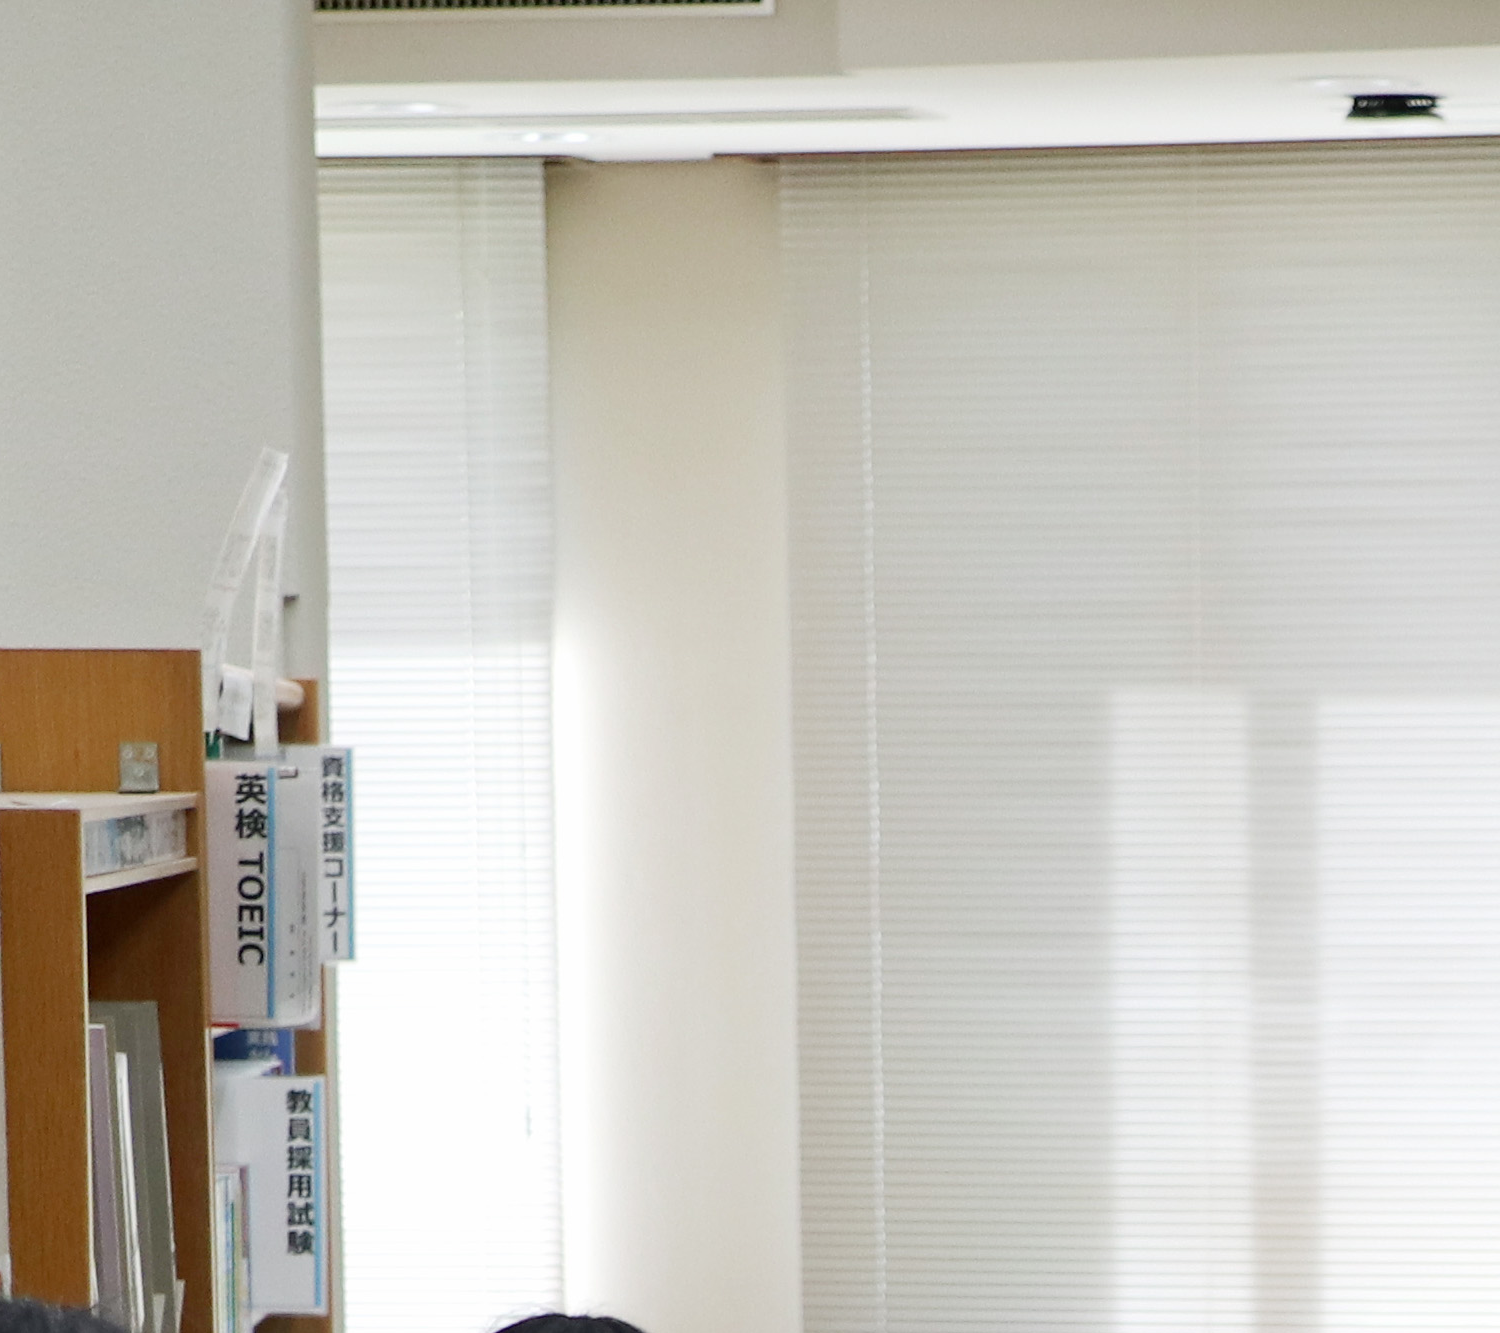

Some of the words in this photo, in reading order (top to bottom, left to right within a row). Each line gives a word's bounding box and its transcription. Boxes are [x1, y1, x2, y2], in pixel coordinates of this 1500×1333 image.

[234, 772, 268, 841] 英検
[320, 755, 347, 956] 資格支援コーナー
[236, 851, 265, 967] TOEIC
[285, 1088, 315, 1256] 教員採用試験
